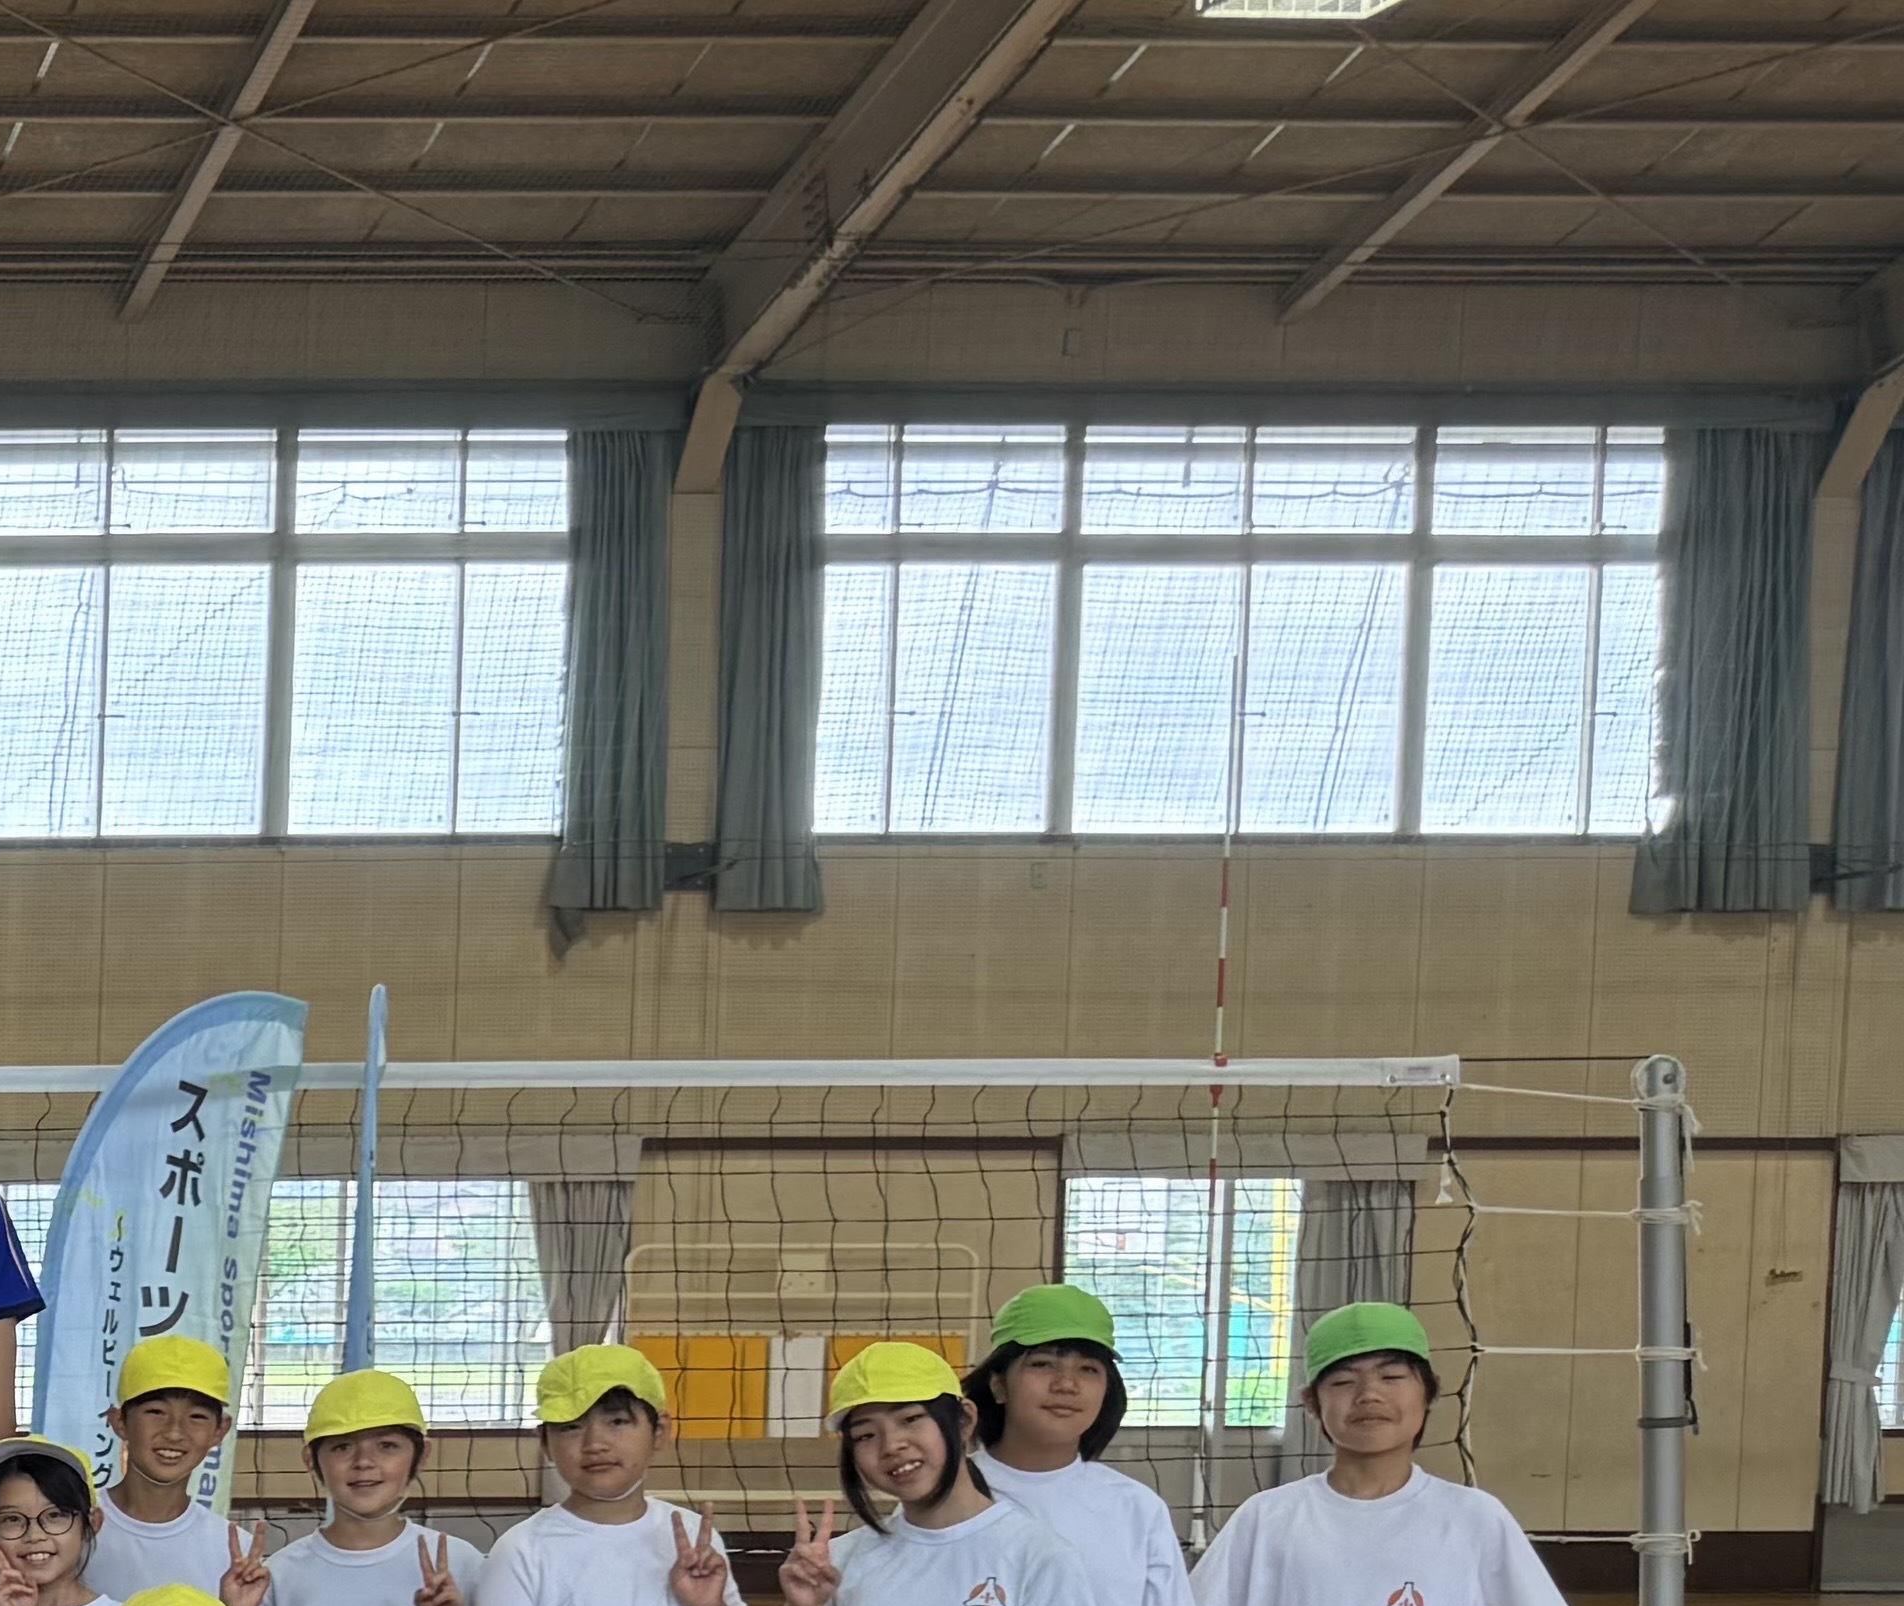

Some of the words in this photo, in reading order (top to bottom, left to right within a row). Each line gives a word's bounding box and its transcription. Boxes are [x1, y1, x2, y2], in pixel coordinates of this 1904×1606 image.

[138, 1079, 209, 1338] スポーツ
[226, 1070, 272, 1240] Mishima
